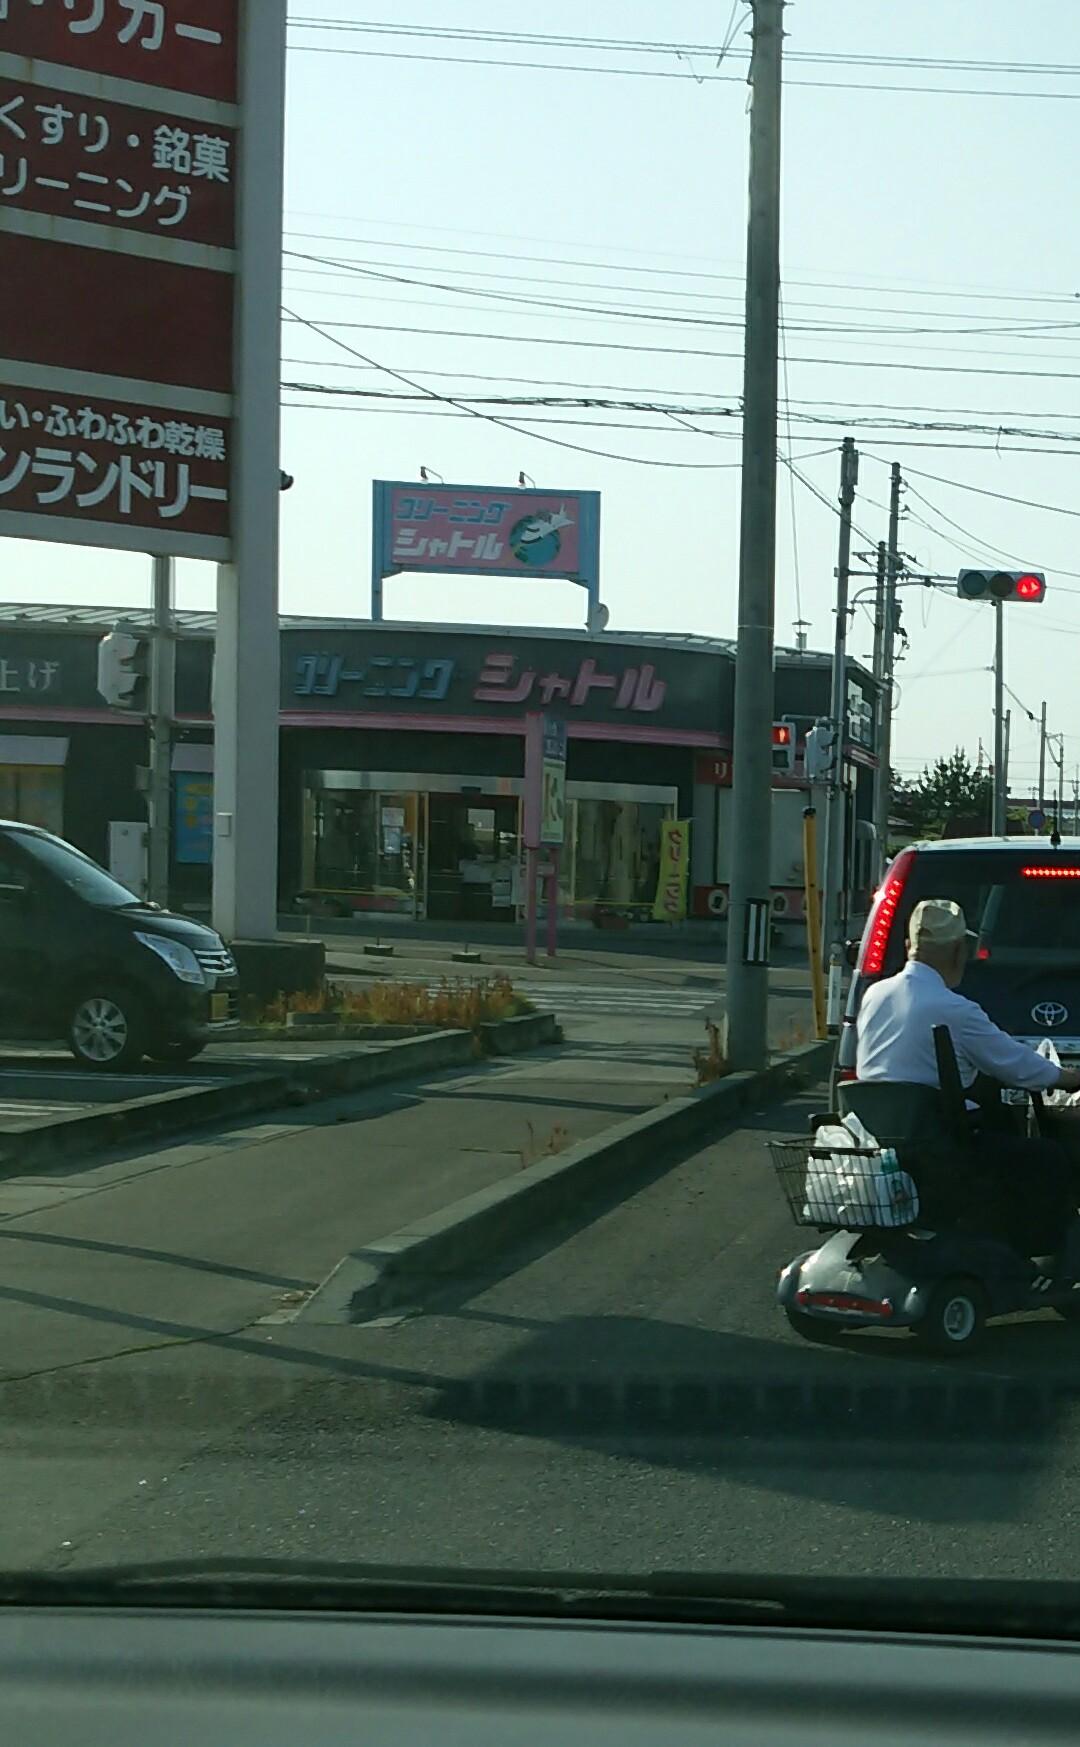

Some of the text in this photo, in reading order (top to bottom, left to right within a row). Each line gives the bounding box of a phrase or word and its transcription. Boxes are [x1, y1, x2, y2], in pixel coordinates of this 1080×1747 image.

[395, 496, 512, 526] クリーニング
[393, 528, 504, 560] シャトル
[473, 653, 668, 712] シャトル
